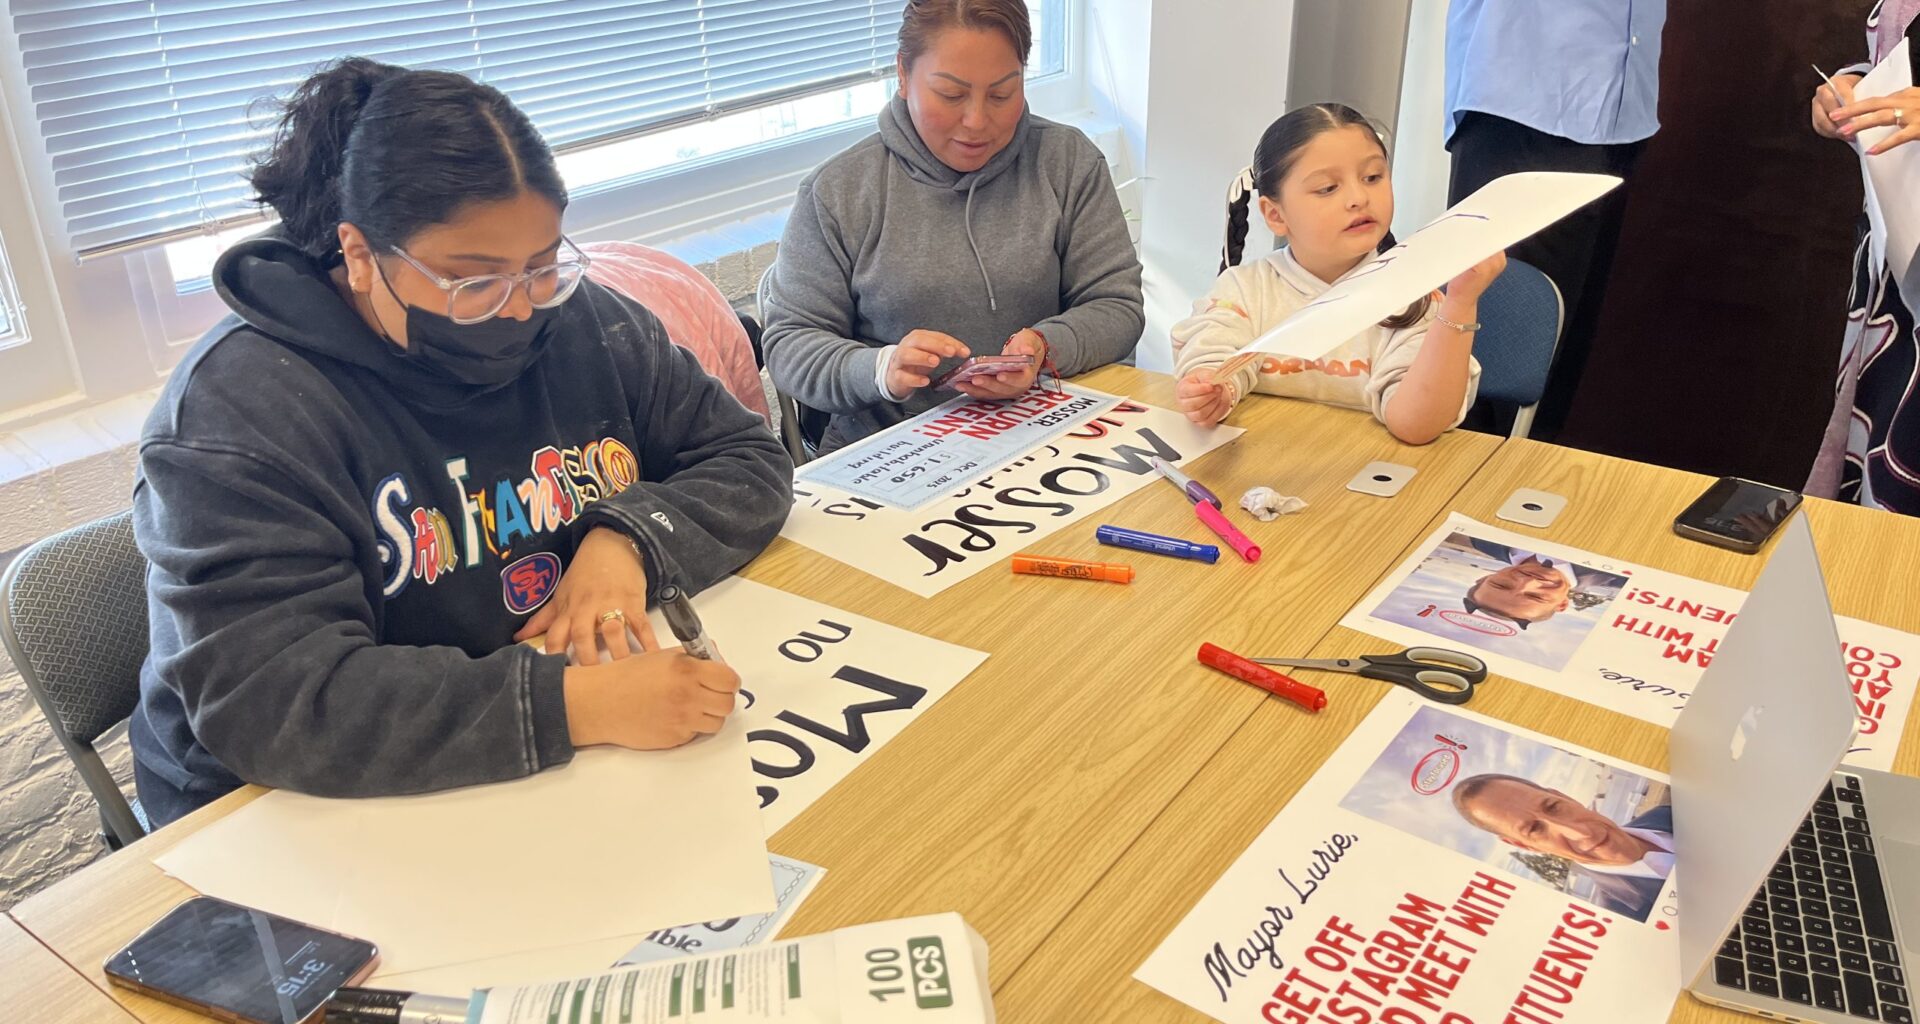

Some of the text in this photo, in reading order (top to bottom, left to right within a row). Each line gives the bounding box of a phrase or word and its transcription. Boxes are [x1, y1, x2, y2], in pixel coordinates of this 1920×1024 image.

[912, 401, 1004, 438] RENT!
[959, 389, 1074, 440] RETURN
[1612, 614, 1694, 647] WITH
[1846, 662, 1893, 687] YO
[1204, 833, 1358, 1003] Mayor Lurie,
[1396, 928, 1478, 1013] MEET
[1444, 871, 1517, 937] WITH
[277, 958, 326, 997] 3:15
[864, 946, 906, 1002] 100
[912, 945, 949, 998] PCS
[1261, 915, 1367, 1024] GET OFF
[1318, 892, 1446, 1024] STAGRAM
